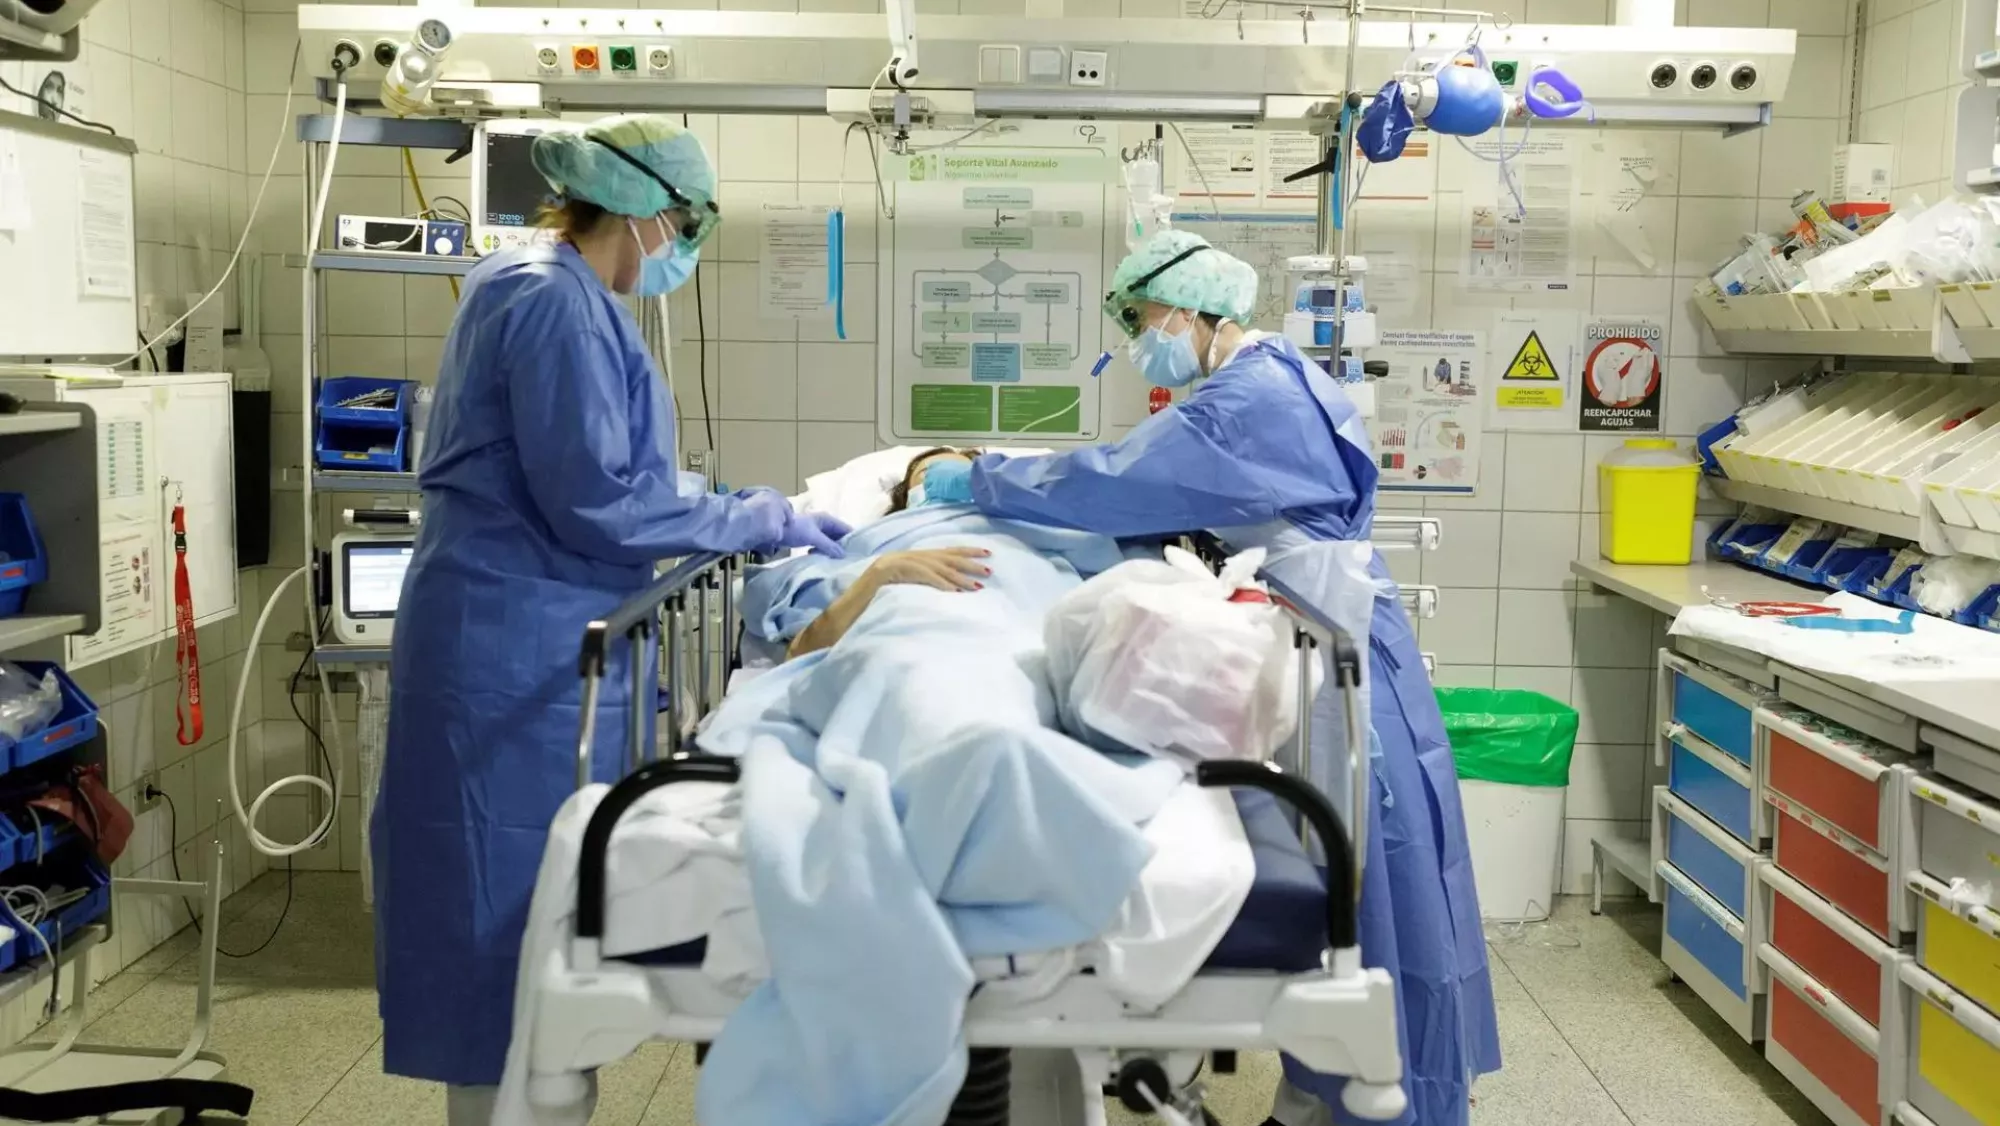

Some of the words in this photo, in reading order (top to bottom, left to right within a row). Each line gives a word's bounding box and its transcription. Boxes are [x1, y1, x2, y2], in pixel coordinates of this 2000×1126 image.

[944, 157, 984, 168] Soporte
[985, 157, 1008, 168] Vital
[1009, 158, 1058, 169] Avanzado
[1588, 327, 1660, 339] PROHIBIDO
[1583, 408, 1652, 418] REENCAPUCHAR
[1600, 417, 1634, 427] AGUJAS
